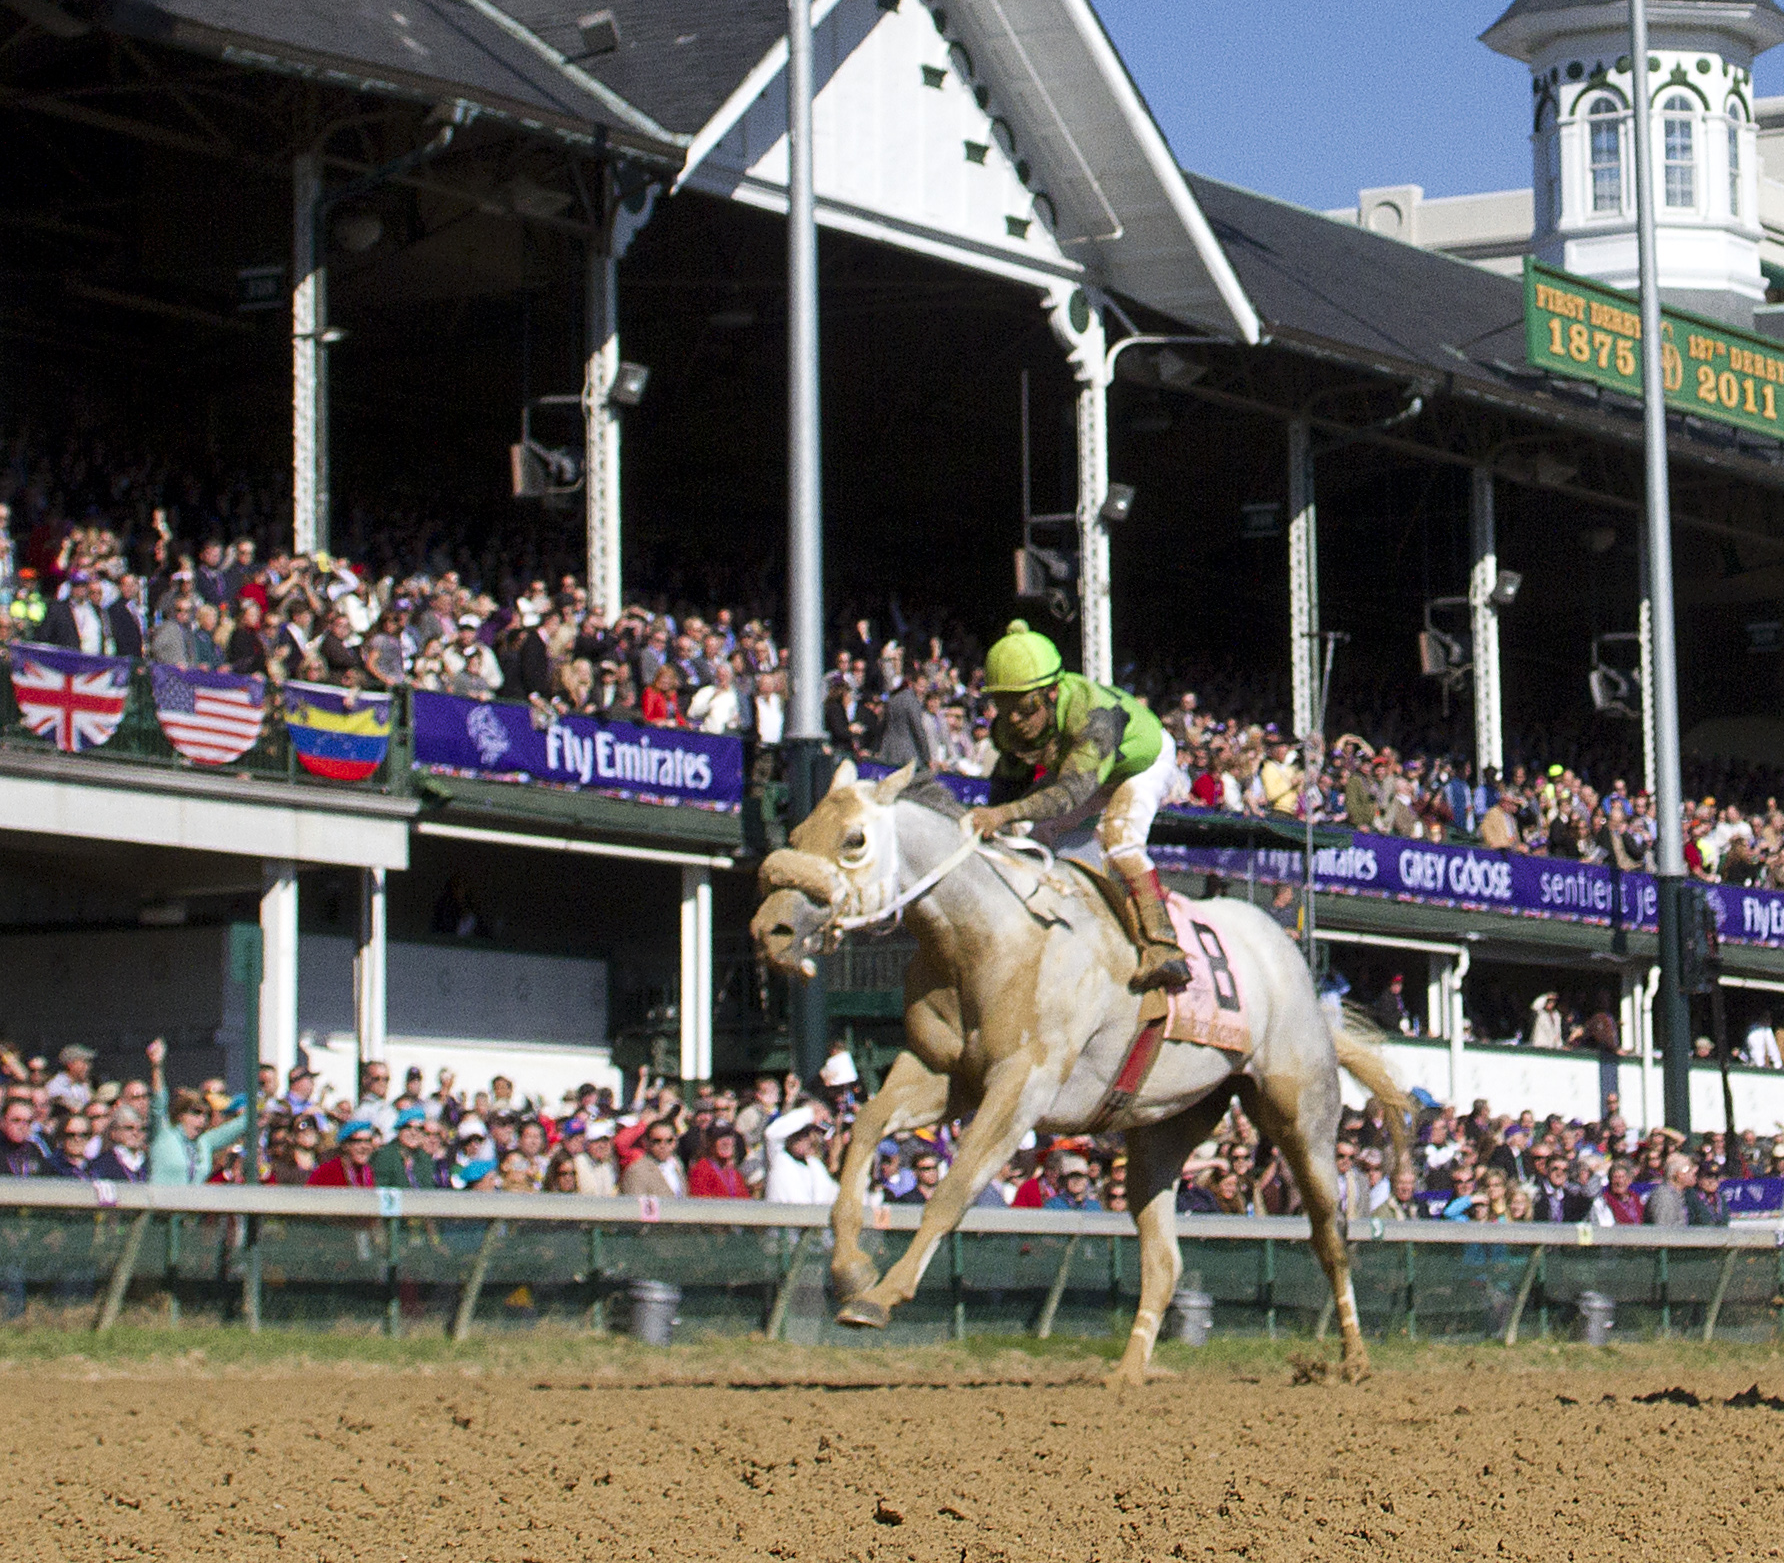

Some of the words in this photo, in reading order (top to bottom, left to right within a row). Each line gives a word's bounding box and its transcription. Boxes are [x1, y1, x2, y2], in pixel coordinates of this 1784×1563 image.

[1535, 283, 1586, 322] FIRST
[1588, 300, 1642, 340] DERBY
[1548, 318, 1636, 376] 1875
[1696, 365, 1778, 421] 2011
[1399, 848, 1447, 892] GREY
[1449, 849, 1513, 901] GOOSE
[1190, 919, 1241, 1013] 8
